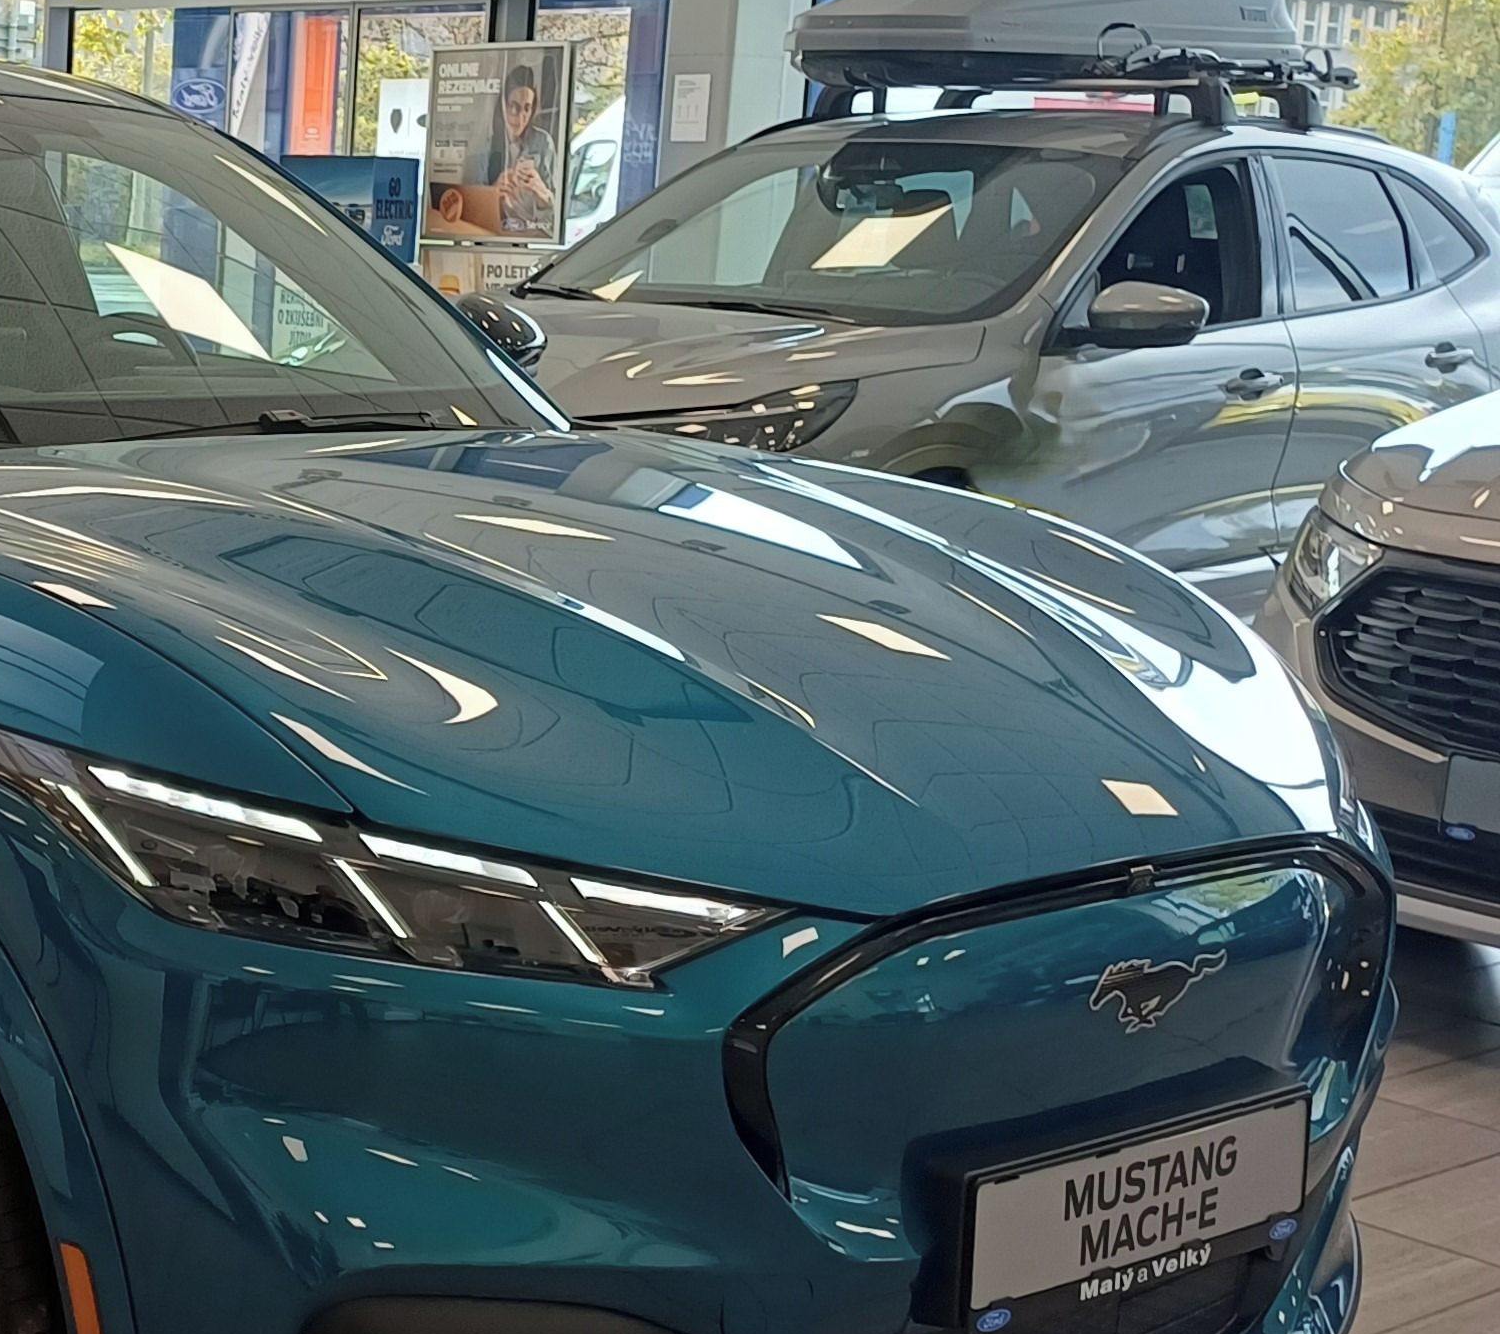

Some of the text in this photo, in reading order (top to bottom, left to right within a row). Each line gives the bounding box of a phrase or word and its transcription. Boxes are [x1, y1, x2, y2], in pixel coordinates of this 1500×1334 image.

[438, 62, 480, 78] ONLINE
[438, 78, 501, 96] REZERVACE
[381, 224, 405, 246] Ford
[486, 264, 503, 279] PO
[1064, 1135, 1238, 1221] MUSTANG
[1080, 1186, 1219, 1267] MACH-E
[1079, 1242, 1213, 1302] Malý a Velký
